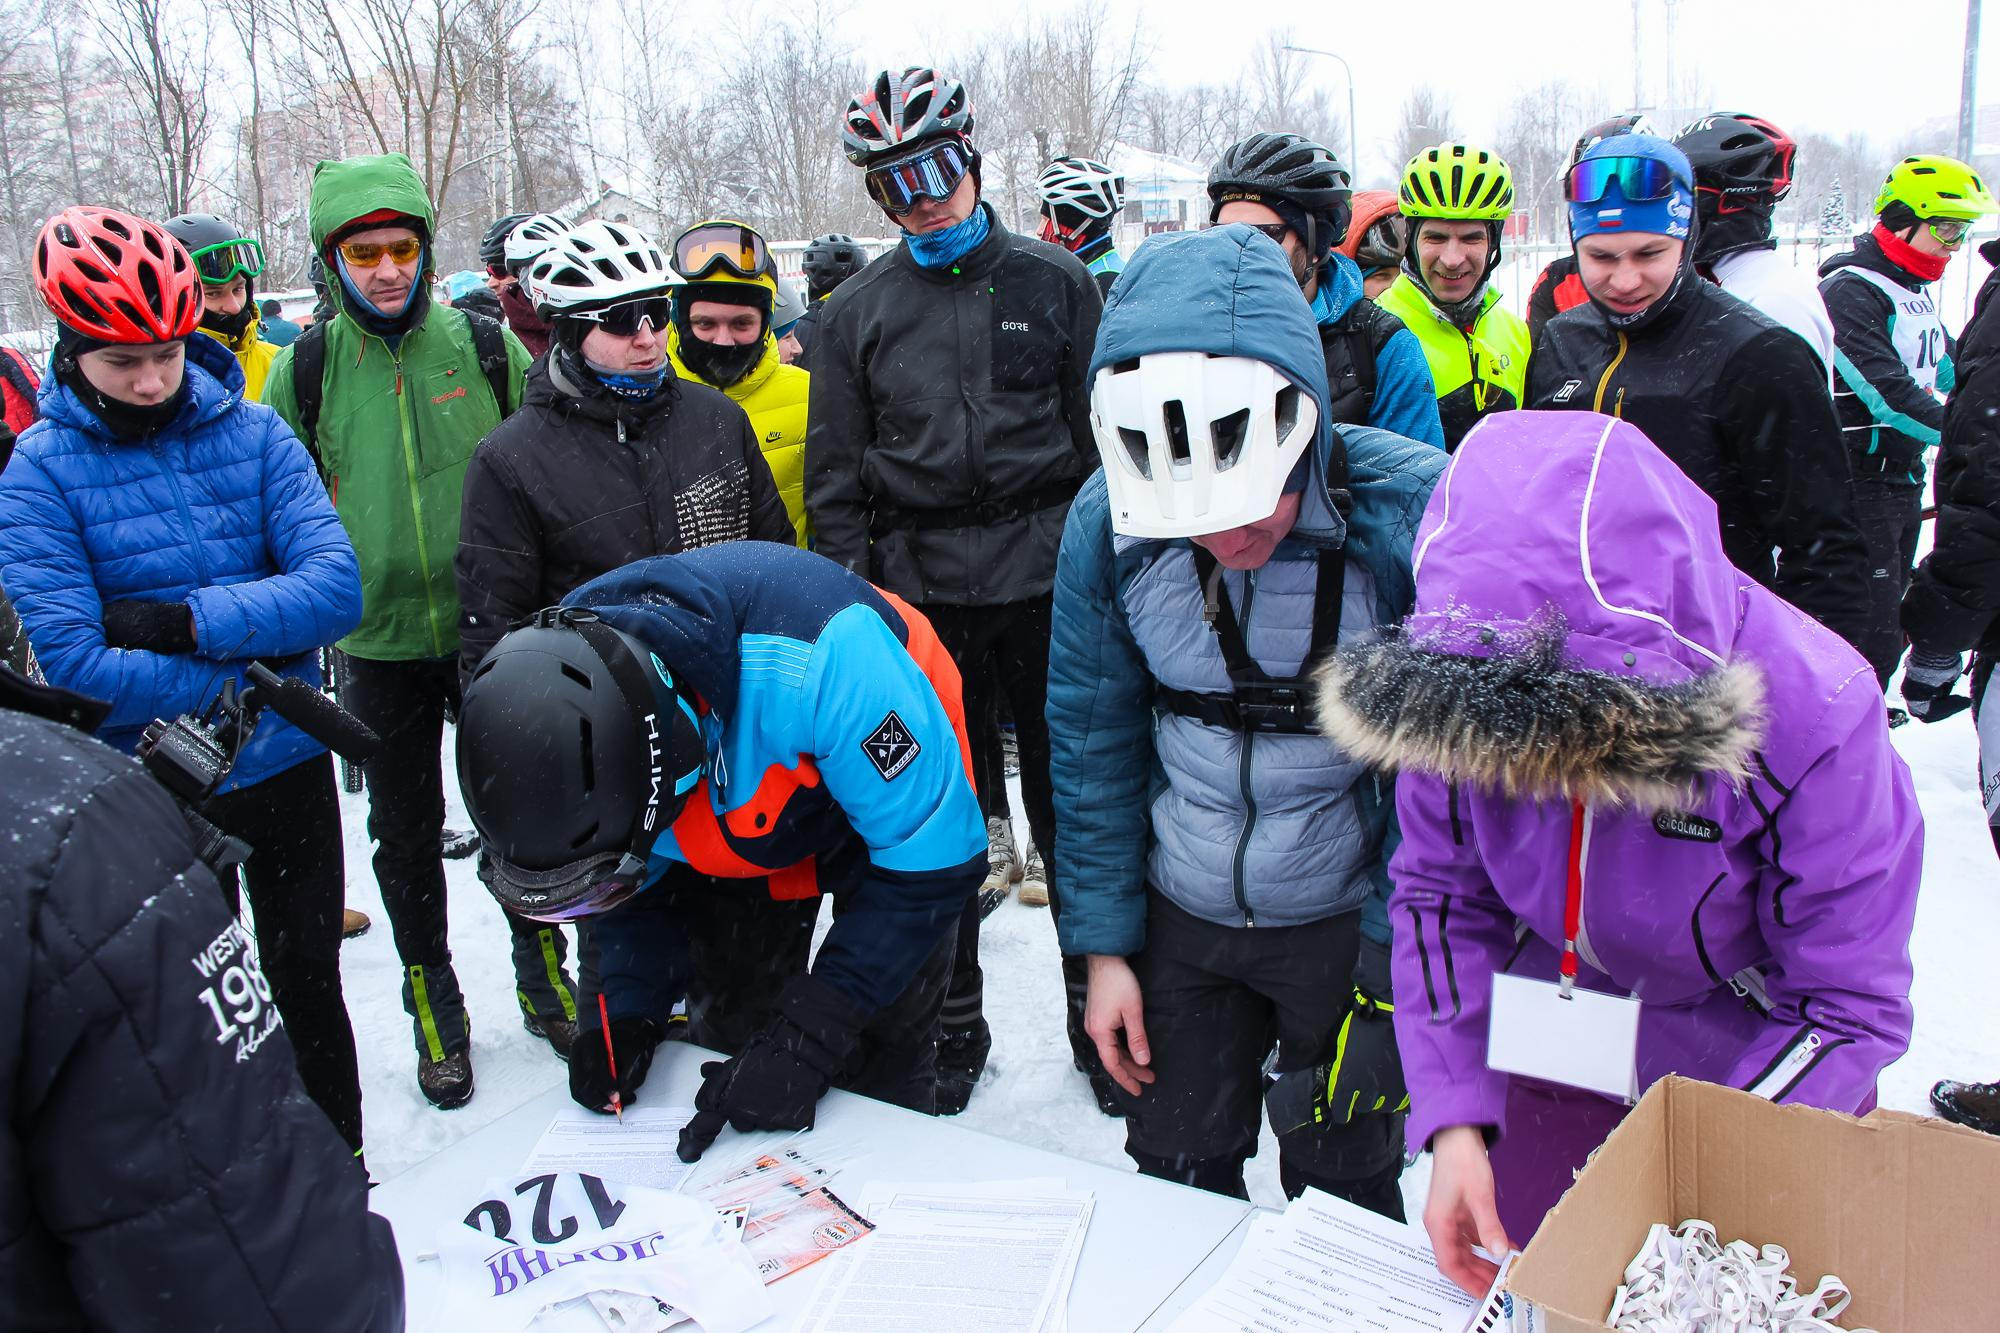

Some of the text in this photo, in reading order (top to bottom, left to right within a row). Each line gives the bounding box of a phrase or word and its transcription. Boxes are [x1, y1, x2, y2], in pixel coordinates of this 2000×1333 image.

[1001, 321, 1029, 331] GORE
[644, 713, 662, 832] SMITH
[1670, 819, 1711, 839] COLMAR
[824, 1227, 845, 1242] 100%
